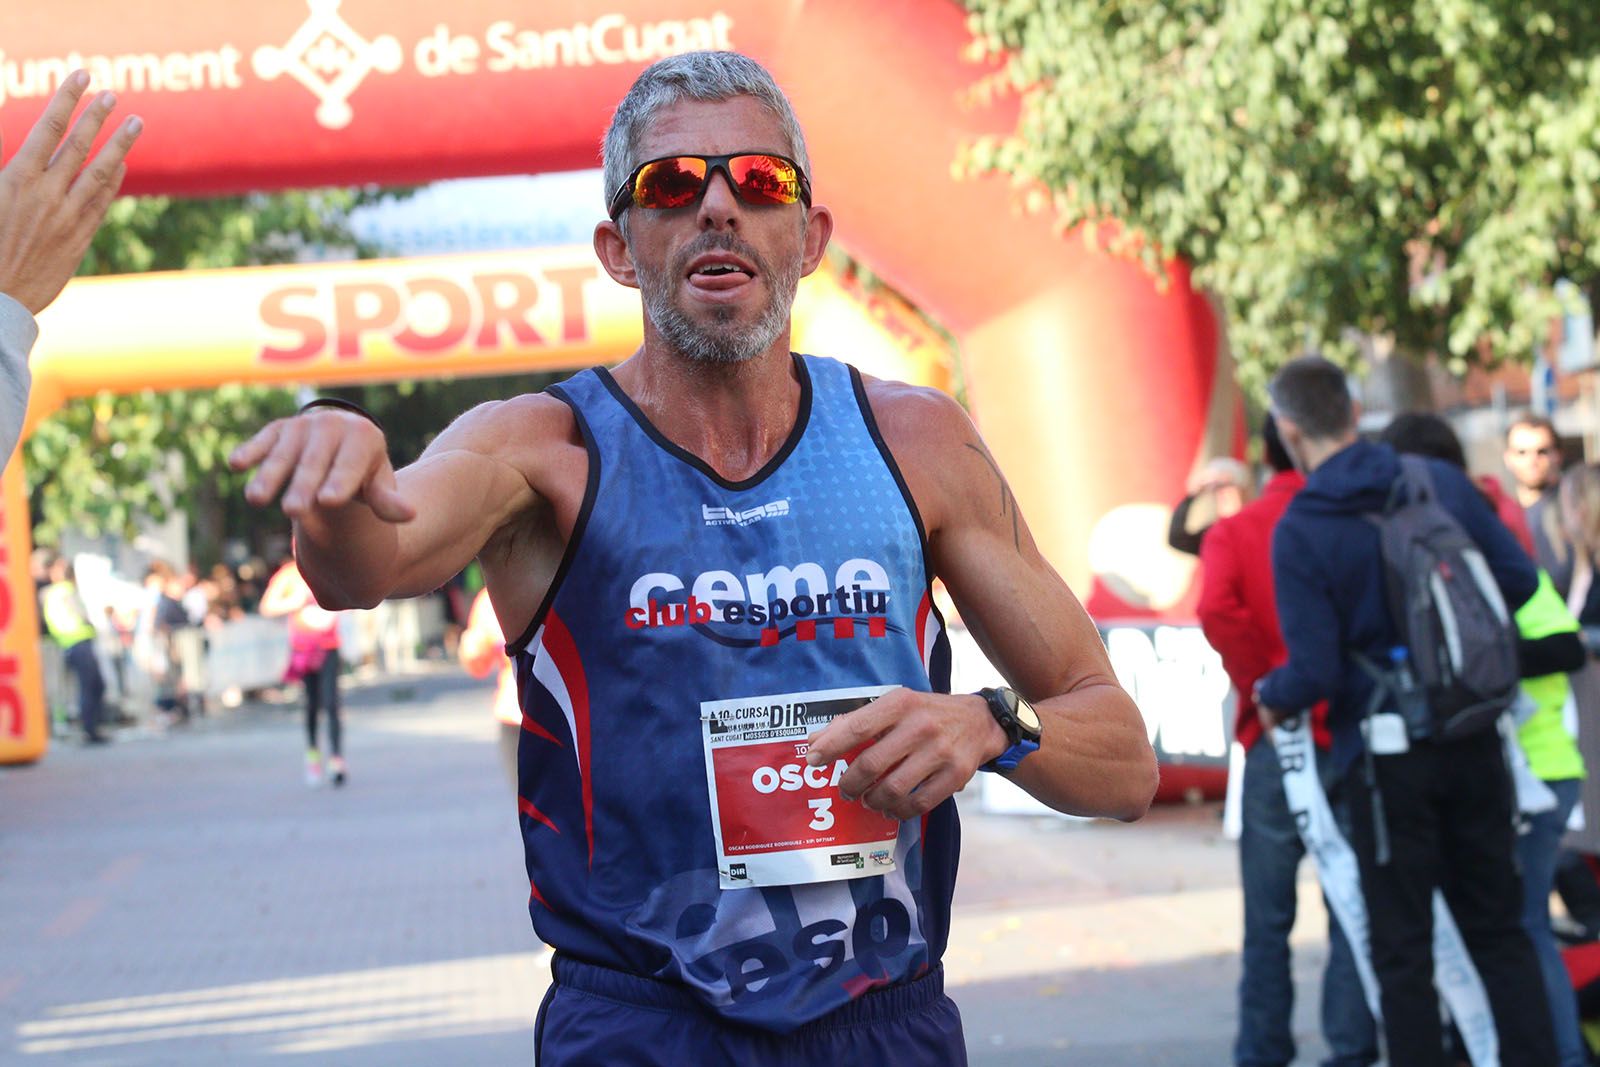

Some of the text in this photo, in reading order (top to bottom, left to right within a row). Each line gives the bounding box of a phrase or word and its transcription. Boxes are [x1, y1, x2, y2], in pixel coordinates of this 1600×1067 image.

[414, 24, 478, 76] de
[259, 267, 597, 363] SPORT
[624, 584, 887, 630] club esportiu
[629, 558, 891, 625] ceme
[735, 706, 769, 720] CURSA
[725, 734, 742, 742] CUGAT
[744, 731, 769, 740] MOSSOS
[770, 727, 806, 738] D'ESQUADRA
[752, 759, 850, 794] OSCA
[807, 797, 835, 831] 3
